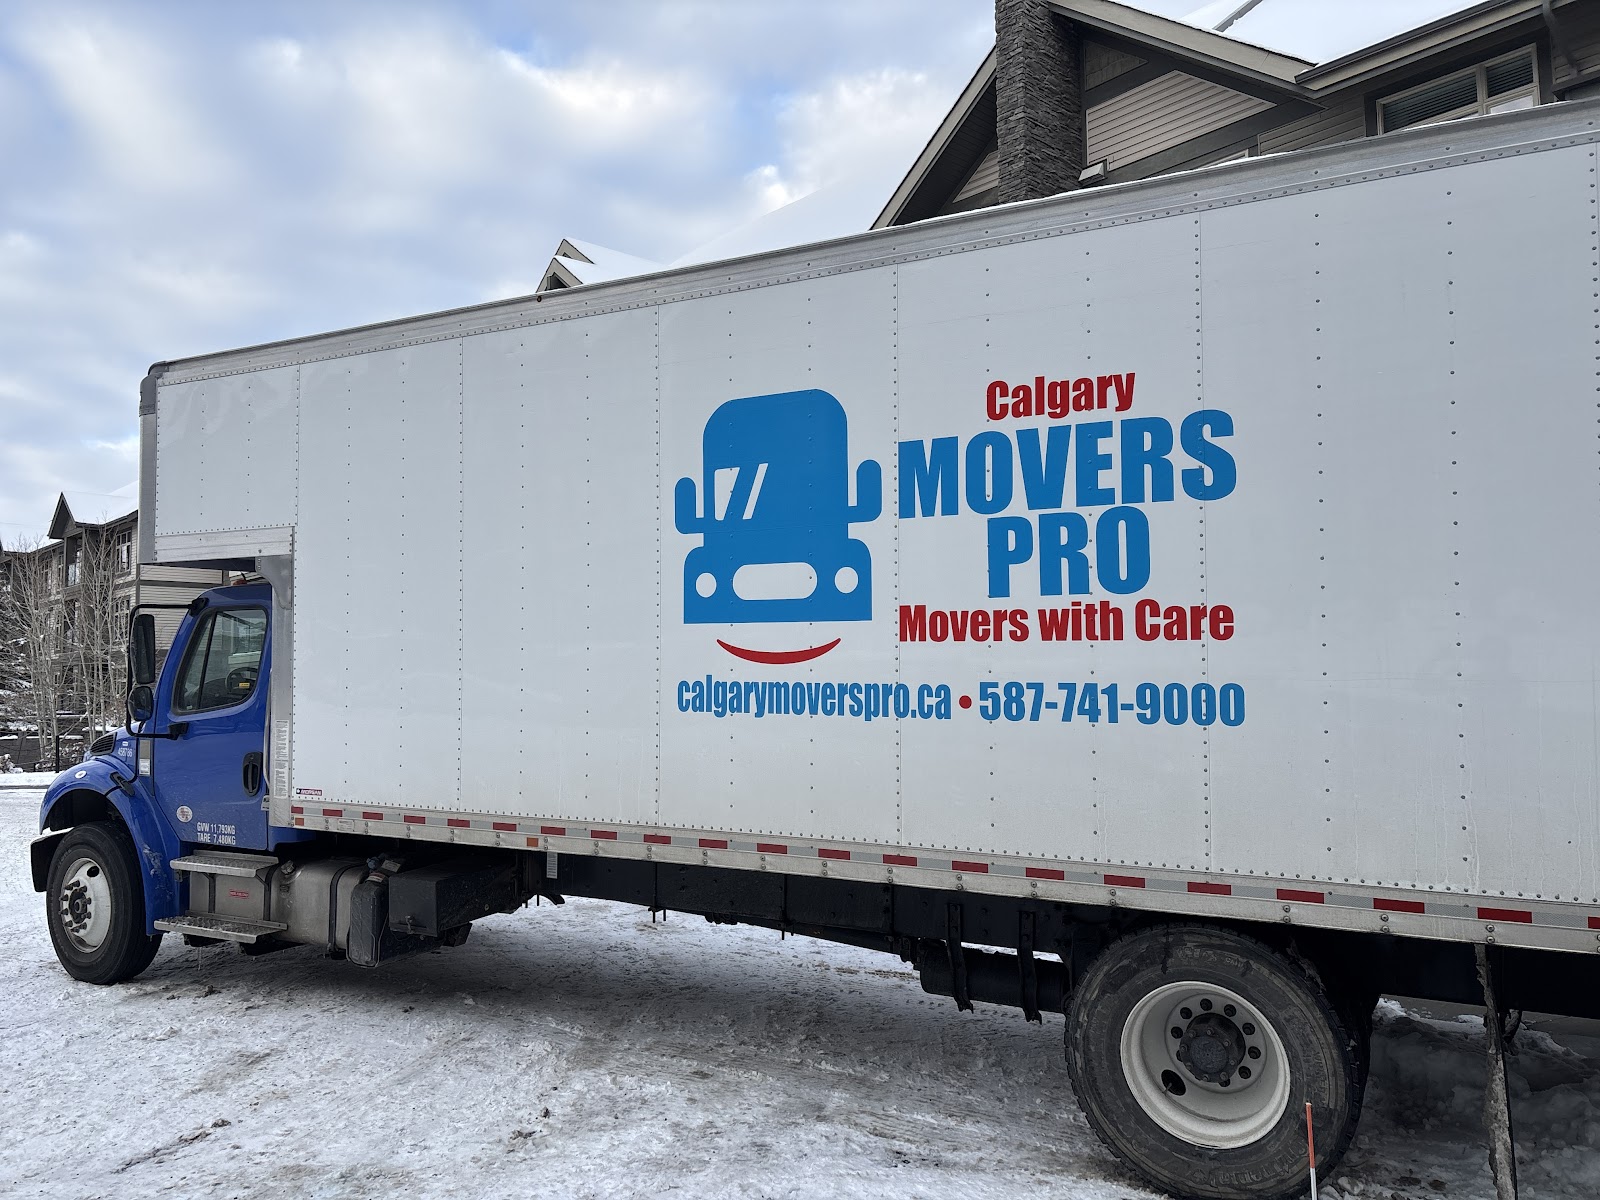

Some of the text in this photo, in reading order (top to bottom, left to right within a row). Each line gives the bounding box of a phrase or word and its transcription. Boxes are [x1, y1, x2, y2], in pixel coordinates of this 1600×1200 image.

[986, 372, 1136, 421] Calgary
[897, 409, 1237, 519] MOVERS
[987, 505, 1151, 599] PRO
[899, 598, 1235, 643] Movers with Care
[677, 674, 1246, 727] calgarymoverspro.ca 587-741-9000
[196, 822, 210, 832] GVW
[197, 832, 211, 843] TARE
